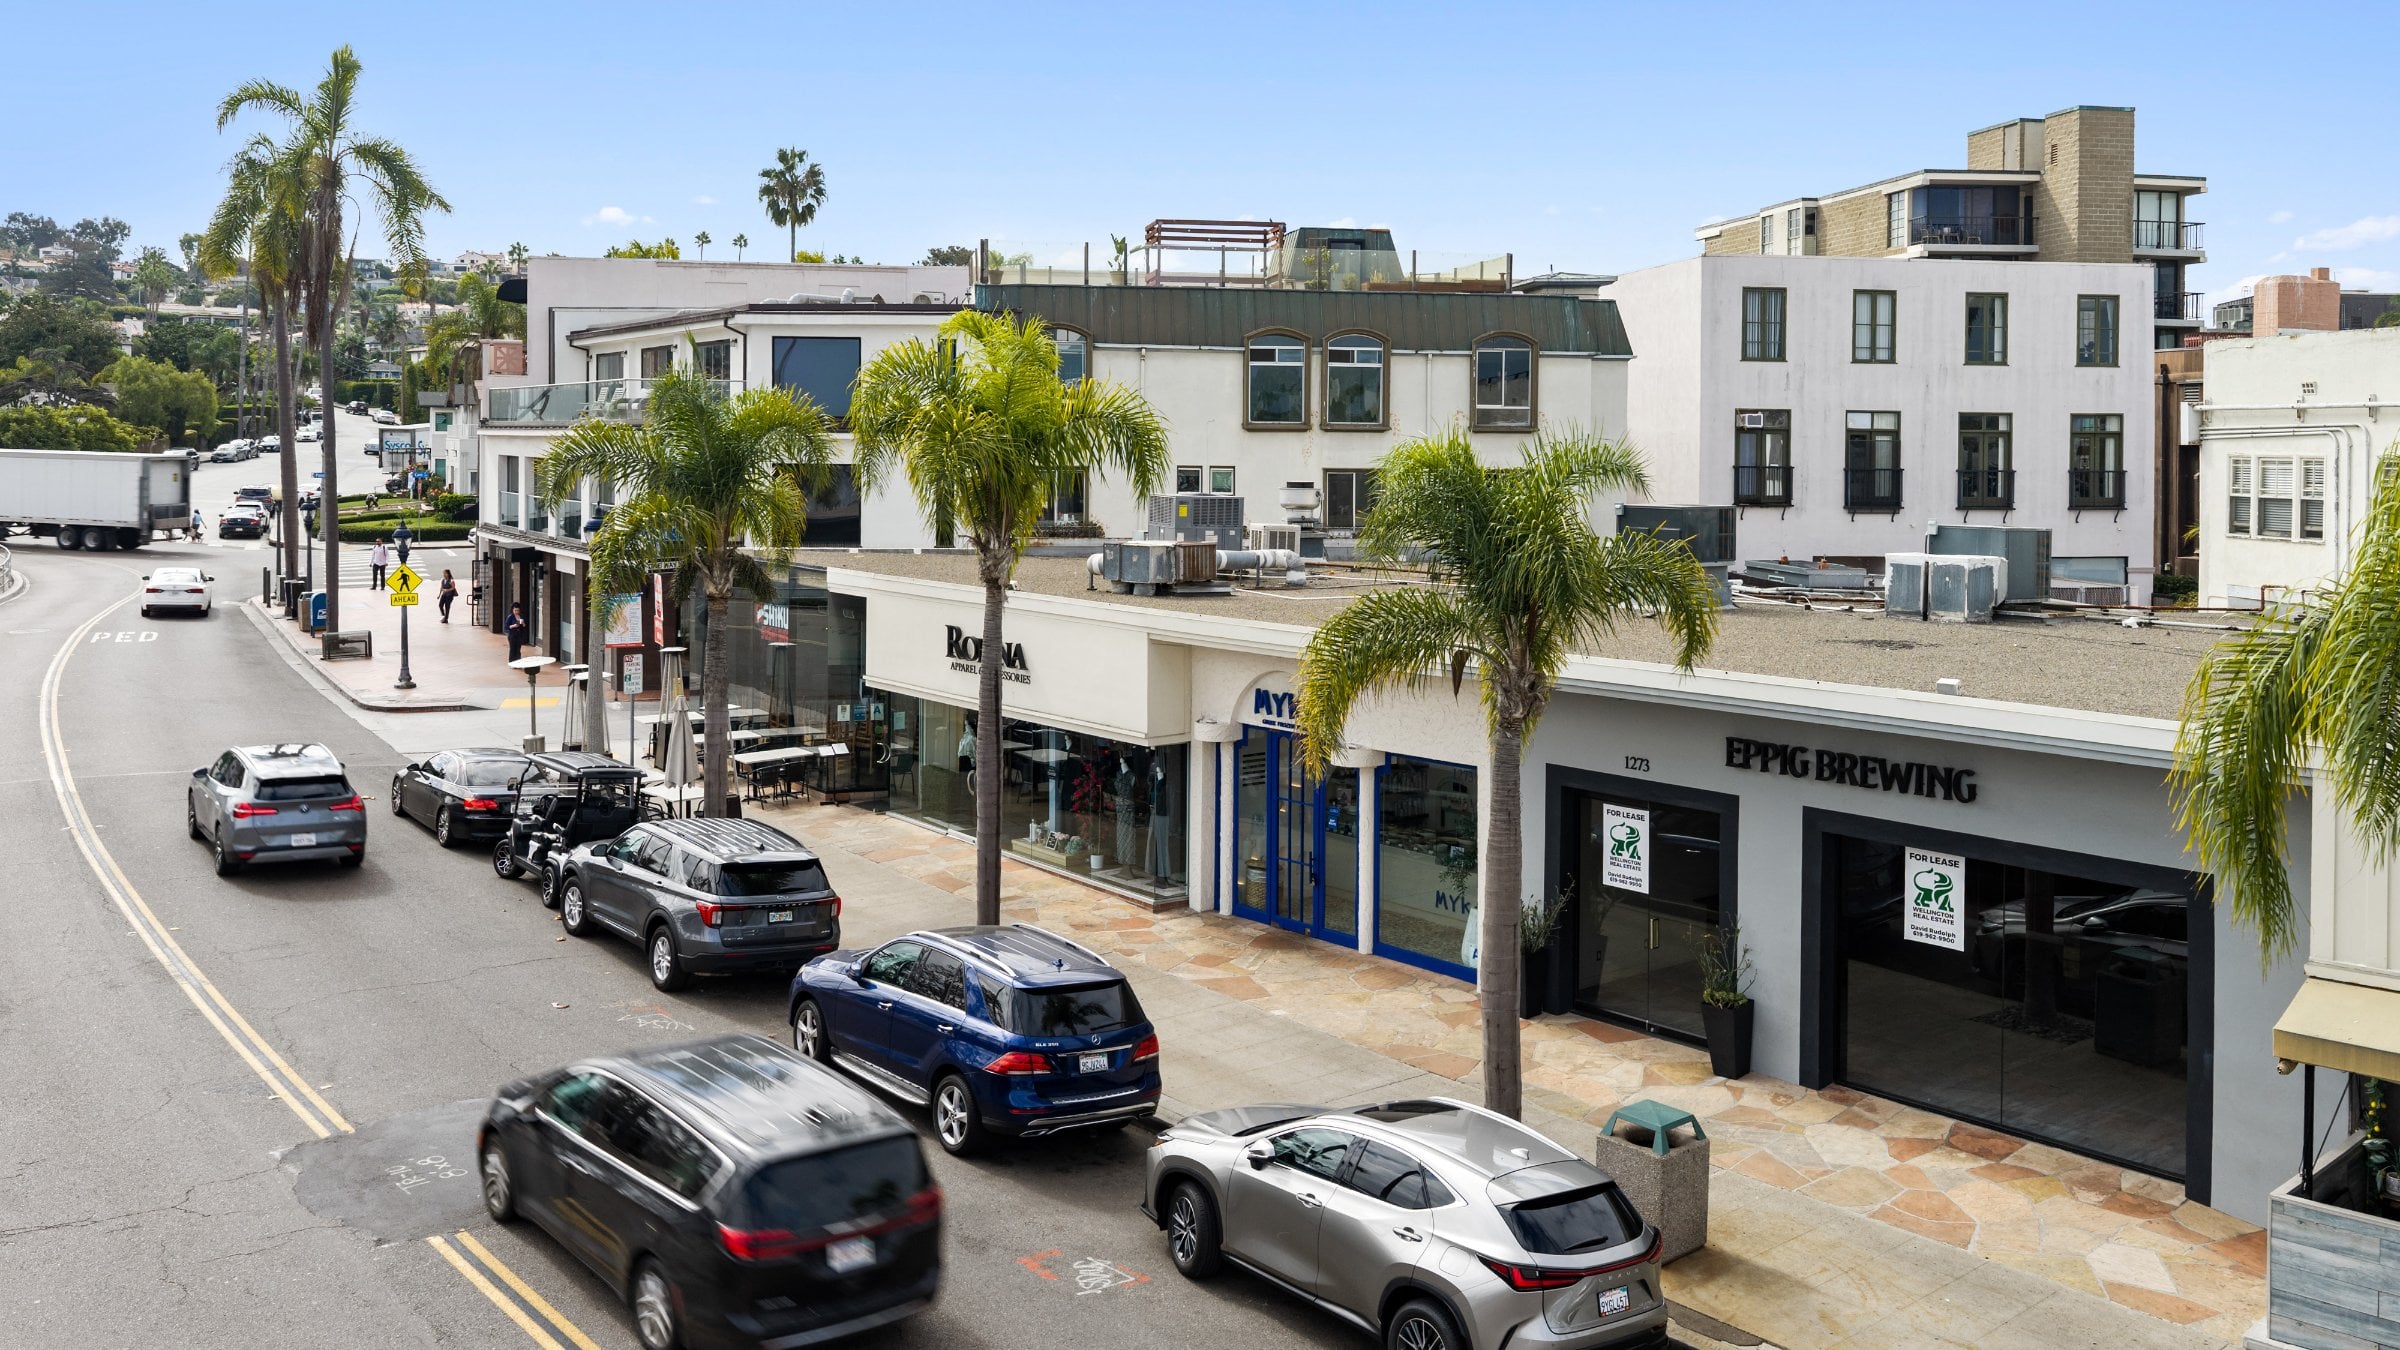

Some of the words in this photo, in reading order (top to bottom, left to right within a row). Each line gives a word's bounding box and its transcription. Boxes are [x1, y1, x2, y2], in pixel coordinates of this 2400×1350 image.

[394, 595, 415, 603] AHEAD
[90, 631, 159, 643] PED
[944, 624, 1028, 671] RONA
[950, 662, 978, 675] APPAREL
[1254, 688, 1296, 719] MYK
[1625, 755, 1650, 772] 1273
[1726, 736, 1809, 778] EPPIG
[1815, 749, 1977, 803] BREWING
[1606, 808, 1621, 818] FOR
[1622, 811, 1646, 822] LEASE
[1609, 855, 1641, 867] WELLINGTON
[1609, 860, 1622, 868] REAL
[1623, 863, 1641, 872] ESTATE
[1909, 852, 1928, 863] FOR
[1930, 856, 1960, 868] LEASE
[1912, 906, 1954, 919] WELLINGTON
[1912, 912, 1930, 921] REAL
[1930, 915, 1955, 926] ESTATE
[1910, 924, 1928, 932] David
[1929, 927, 1956, 939] Rudolph
[1598, 1267, 1640, 1283] LEXUS
